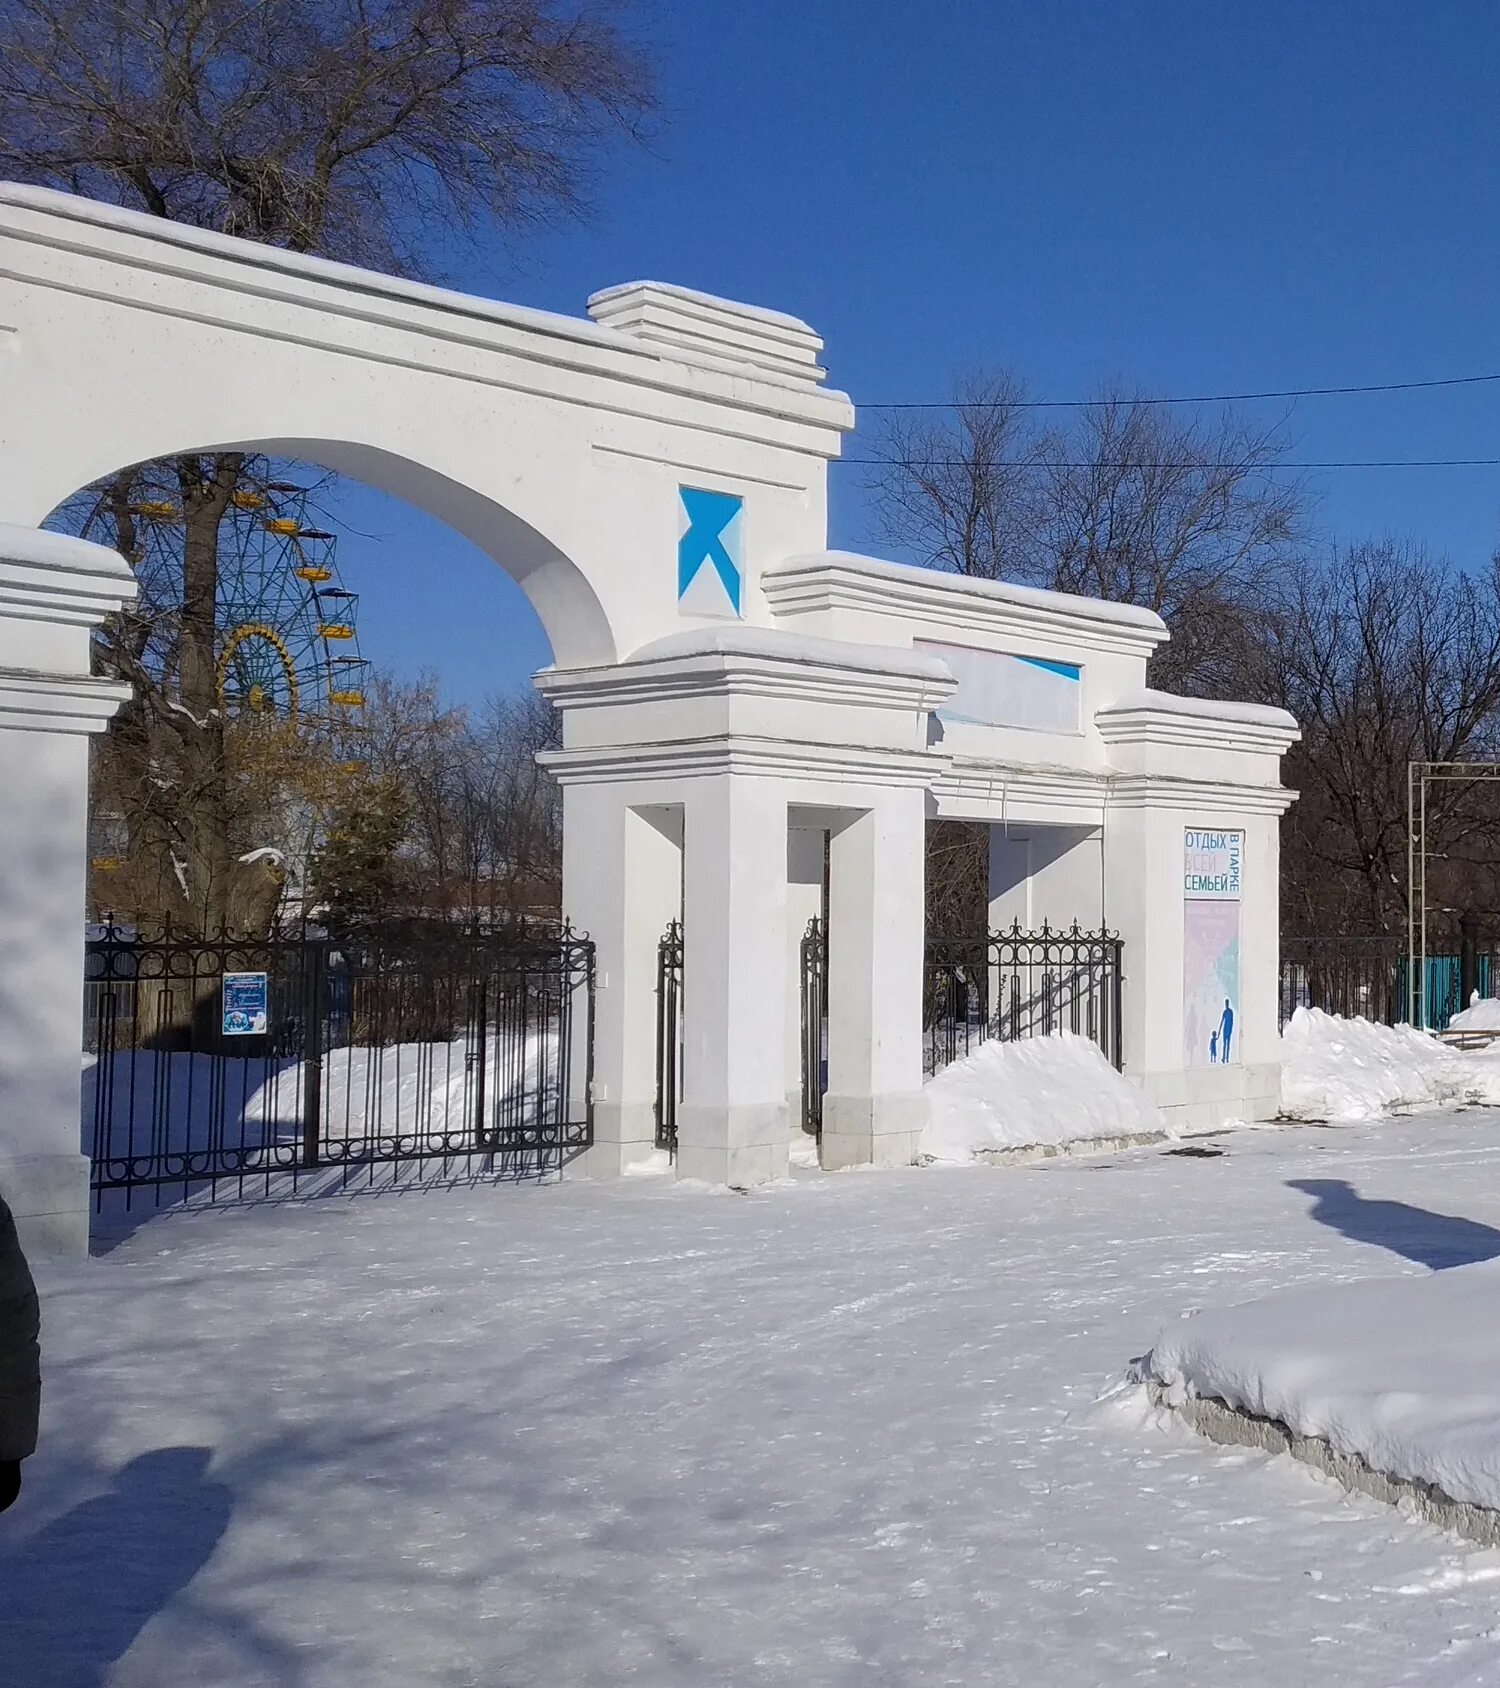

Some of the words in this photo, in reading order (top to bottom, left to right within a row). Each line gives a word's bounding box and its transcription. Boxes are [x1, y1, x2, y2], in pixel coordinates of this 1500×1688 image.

[1185, 832, 1226, 851] ОТДЫХ
[1230, 834, 1239, 843] В
[1185, 852, 1216, 872] ВСЕЙ
[1230, 847, 1239, 892] ПАРКЕ
[1185, 873, 1228, 891] СЕМЬЕЙ
